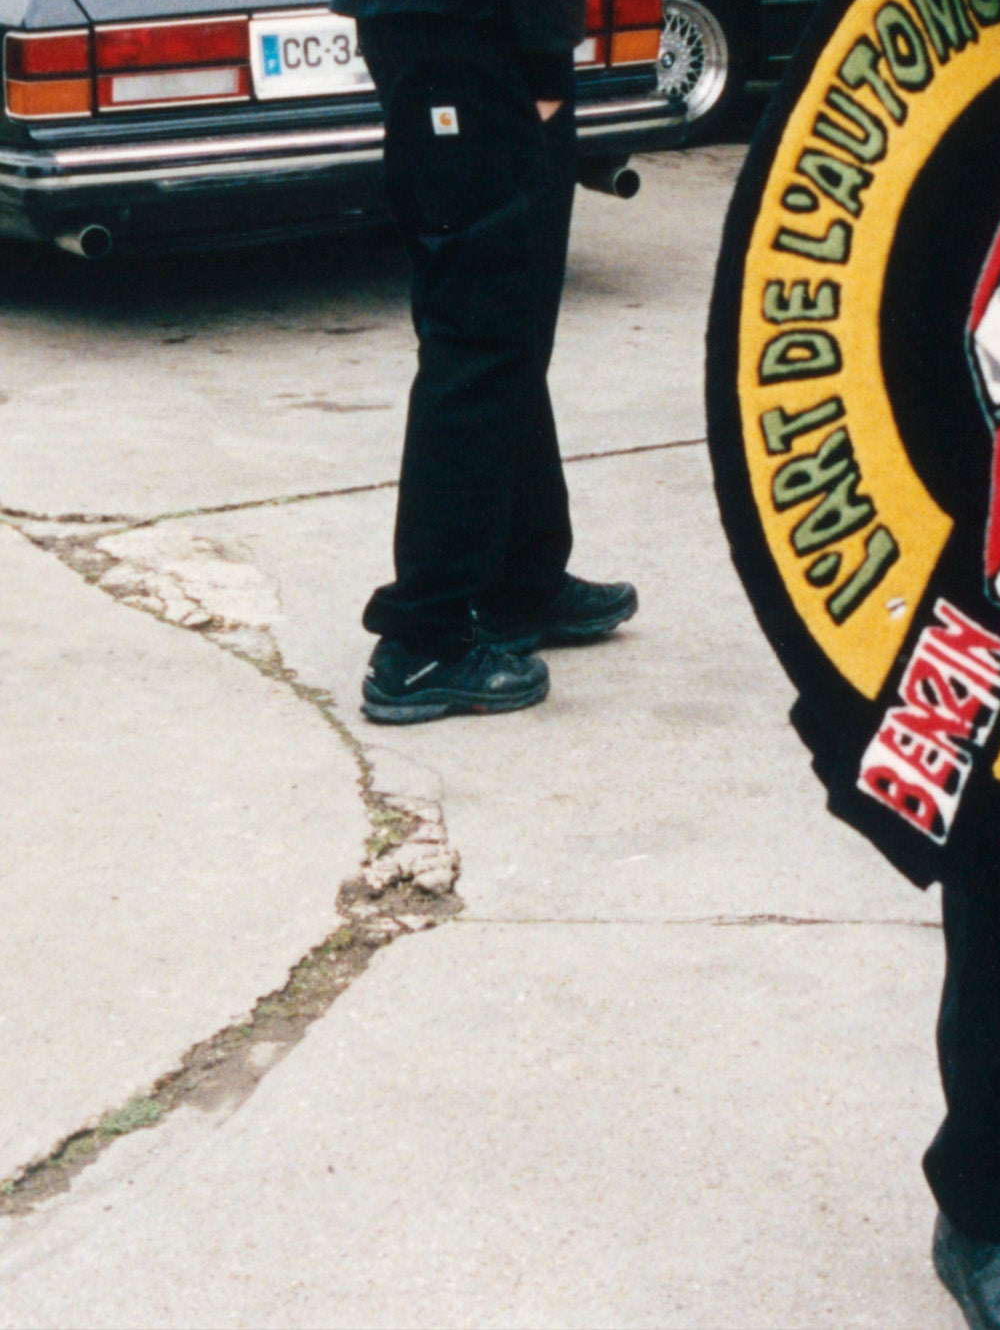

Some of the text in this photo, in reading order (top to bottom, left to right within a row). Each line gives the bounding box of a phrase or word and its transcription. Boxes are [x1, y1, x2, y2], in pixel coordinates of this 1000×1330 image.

[283, 34, 361, 69] CC-3
[759, 277, 842, 386] DE
[761, 394, 900, 627] L'ART
